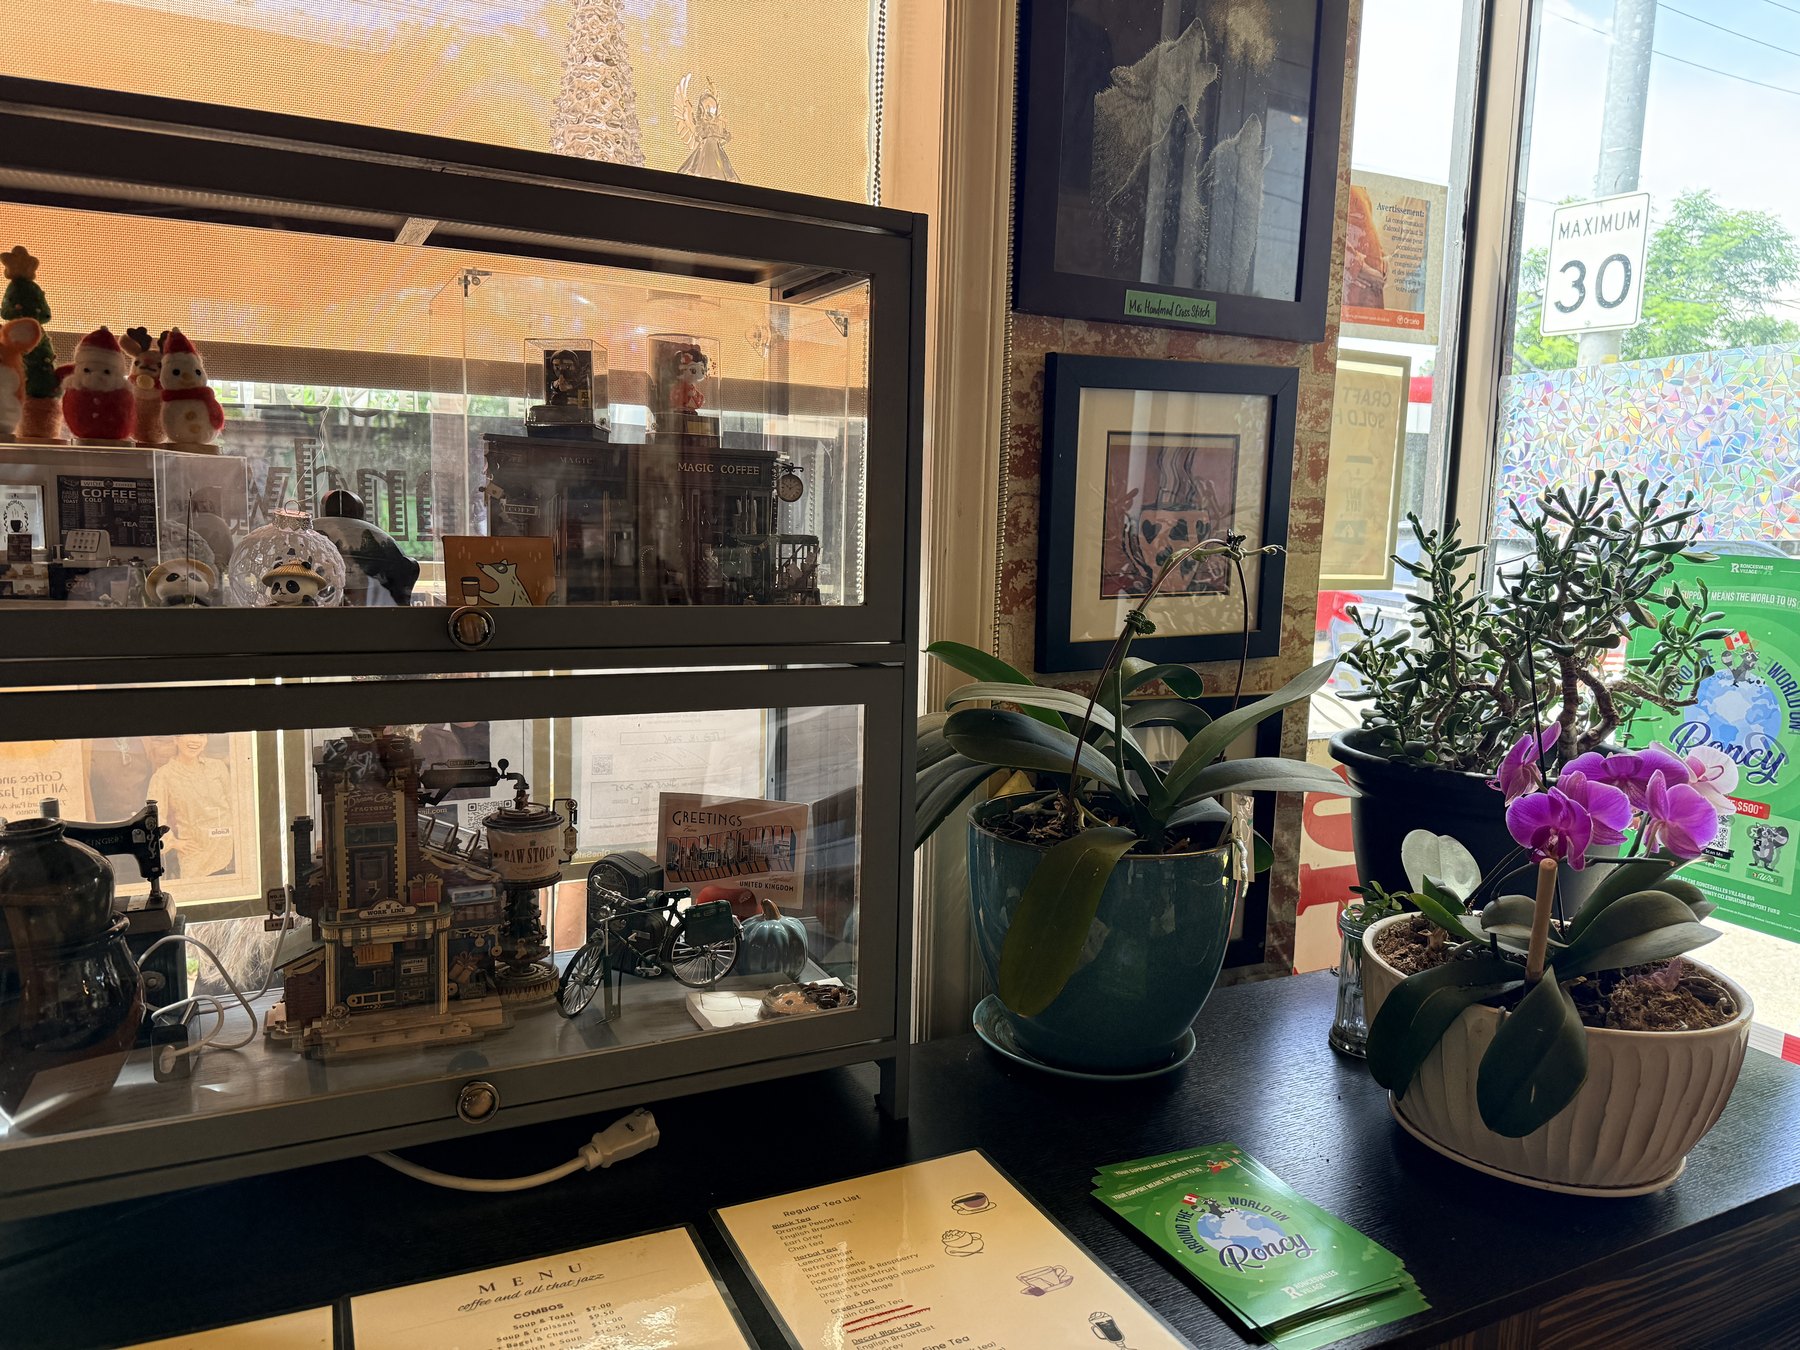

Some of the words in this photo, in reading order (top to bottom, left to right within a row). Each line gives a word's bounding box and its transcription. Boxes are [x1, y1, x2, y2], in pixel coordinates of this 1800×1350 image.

[1376, 202, 1424, 217] Avertissement:
[1558, 209, 1640, 240] MAXIMUM
[1554, 254, 1632, 313] 30
[1191, 304, 1210, 319] Stitch
[677, 462, 714, 474] MAGIC
[720, 464, 760, 476] COFFEE
[81, 488, 137, 499] COFFEE
[1711, 592, 1735, 602] MEANS
[1736, 592, 1750, 602] THE
[1751, 593, 1774, 604] WORLD
[1776, 595, 1786, 605] TO
[1786, 596, 1797, 607] US
[672, 810, 743, 827] GREETINGS
[504, 849, 526, 864] RAW
[526, 845, 555, 864] STOCK
[666, 825, 796, 882] BIRMINGHAM
[739, 881, 763, 889] UNITED
[764, 882, 794, 892] KINGDOM
[367, 908, 385, 916] WORK
[390, 907, 406, 915] LINE
[783, 1204, 820, 1217] Regular
[823, 1199, 842, 1208] Tea
[843, 1194, 861, 1203] List
[1228, 1196, 1271, 1214] WORLD
[772, 1220, 794, 1230] Black
[795, 1216, 812, 1225] Tea
[1175, 1209, 1194, 1225] THE
[1271, 1209, 1290, 1222] ON
[776, 1224, 807, 1235] Orange
[809, 1217, 834, 1228] Pekoe
[780, 1230, 810, 1241] English
[811, 1219, 853, 1233] Breakfast
[784, 1237, 801, 1247] Earl
[803, 1233, 823, 1244] Grey
[788, 1244, 807, 1253] Chai
[809, 1240, 824, 1248] tea
[1175, 1225, 1208, 1255] AROUND
[794, 1250, 821, 1262] Herbal
[821, 1246, 838, 1254] Tea
[1219, 1230, 1317, 1273] Roncy
[798, 1256, 824, 1267] Lemon
[802, 1260, 835, 1273] Refresh
[810, 1267, 866, 1286] Pomegranate
[877, 1253, 919, 1268] Raspberry
[478, 1263, 584, 1294] MENU
[806, 1269, 827, 1279] Pure
[871, 1273, 900, 1284] Mango
[457, 1299, 492, 1313] coffee
[494, 1290, 522, 1303] and
[524, 1284, 545, 1297] all
[545, 1278, 574, 1290] that
[573, 1273, 605, 1287] jazz
[815, 1281, 843, 1293] Mango
[863, 1282, 894, 1295] Orange
[858, 1298, 875, 1307] Tea
[859, 1302, 886, 1314] Green
[888, 1298, 904, 1307] Tea
[512, 1321, 536, 1331] Soup
[549, 1311, 575, 1322] Toast
[585, 1302, 612, 1313] $7.00
[513, 1303, 564, 1320] COMBOS
[496, 1332, 520, 1342] Soup
[533, 1319, 577, 1334] Croissant
[588, 1309, 615, 1321] $9.50
[852, 1334, 879, 1345] Decaf
[880, 1326, 903, 1337] Black
[904, 1320, 922, 1330] Tea
[890, 1324, 935, 1342] Breakfast
[506, 1338, 533, 1349] Bagel
[546, 1327, 580, 1339] Cheese
[559, 1335, 583, 1346] Soup
[949, 1335, 970, 1347] Tea
